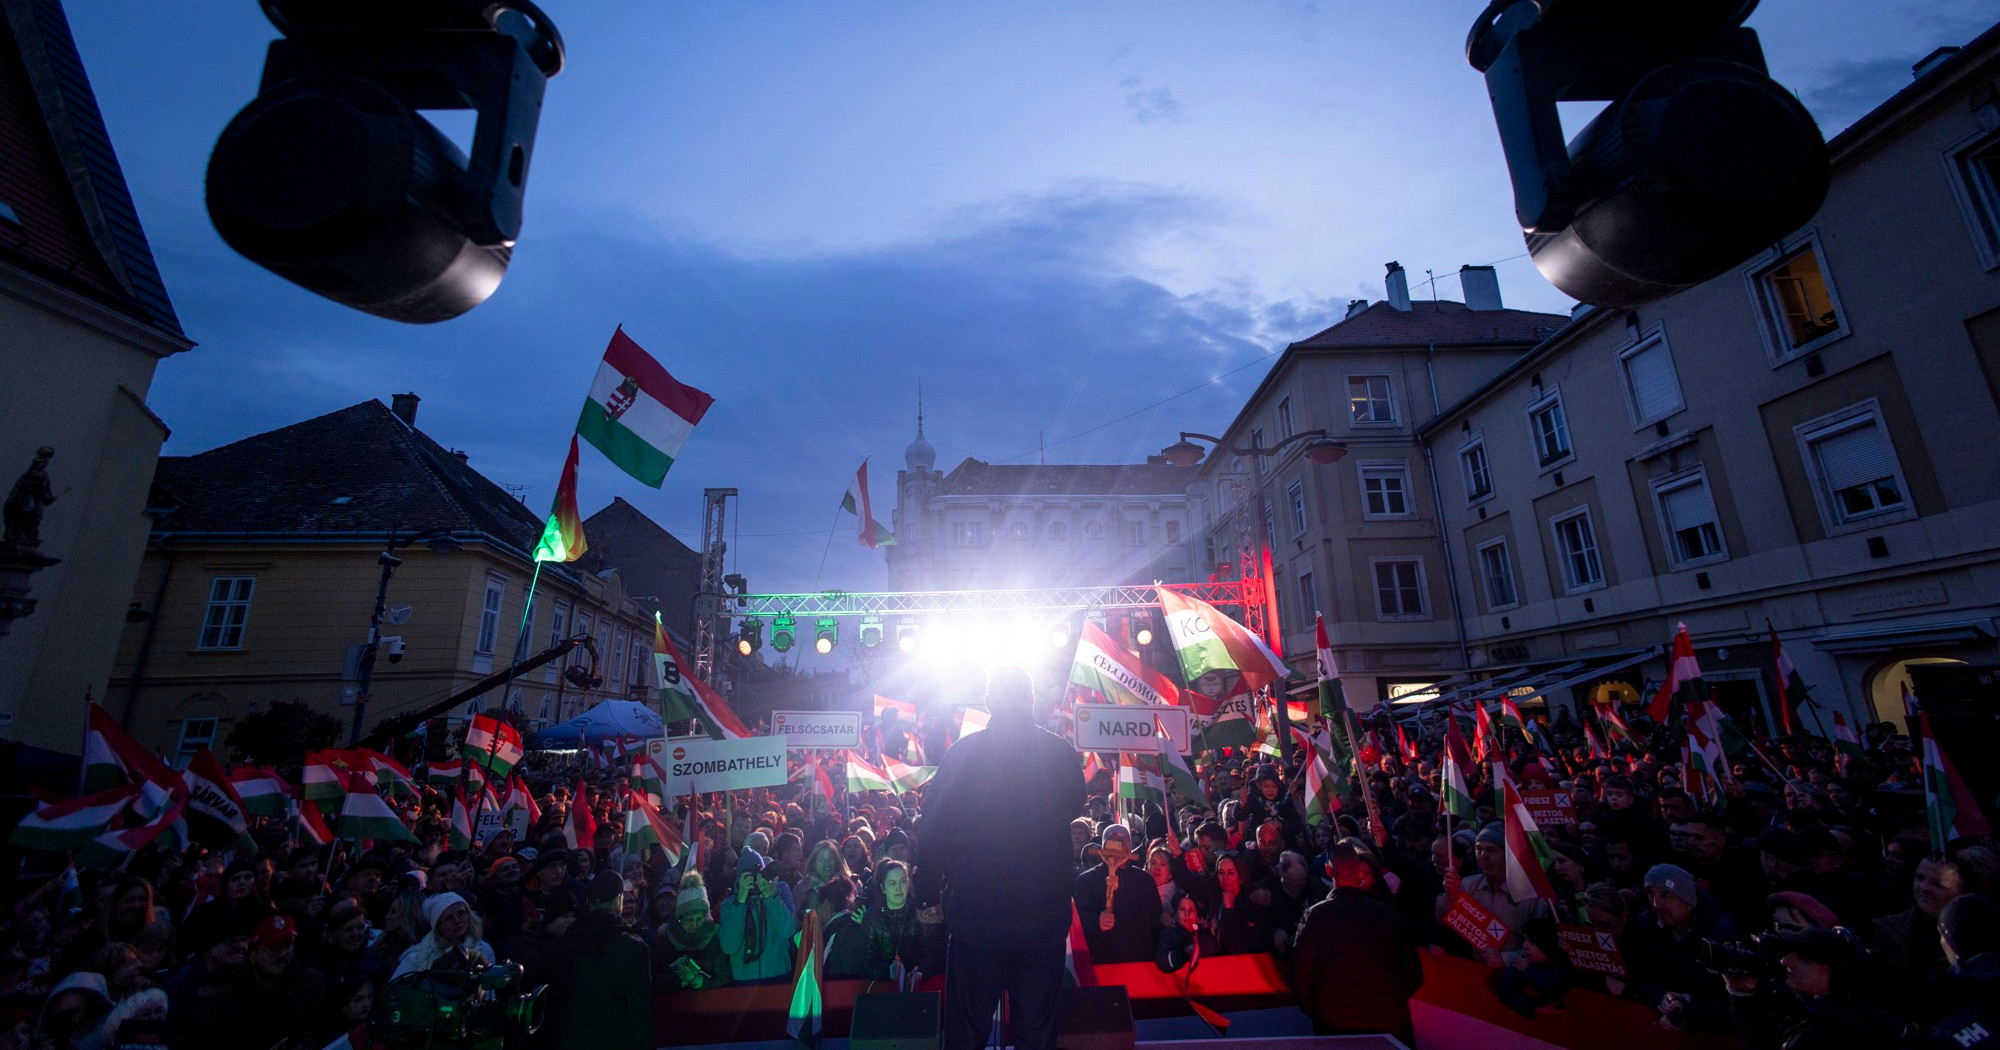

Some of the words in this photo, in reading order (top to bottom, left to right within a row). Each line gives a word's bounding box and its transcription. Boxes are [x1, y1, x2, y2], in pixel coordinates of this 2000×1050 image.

[1093, 654, 1163, 705] CELLDÖMÖL
[778, 721, 854, 735] FELSŐCSATÁR
[672, 754, 782, 777] SZOMBATHELY
[190, 785, 238, 819] SÁRVAR
[1523, 796, 1551, 805] FIDESZ
[1457, 896, 1487, 923] FIDESZ
[1447, 914, 1488, 949] VÁLASZT
[1457, 914, 1488, 942] BIZTOS
[1562, 930, 1593, 944] FIDESZ
[1569, 956, 1626, 975] VÁLASZTÁS
[1575, 948, 1611, 963] BIZTOS
[1952, 1022, 1991, 1049] HH
